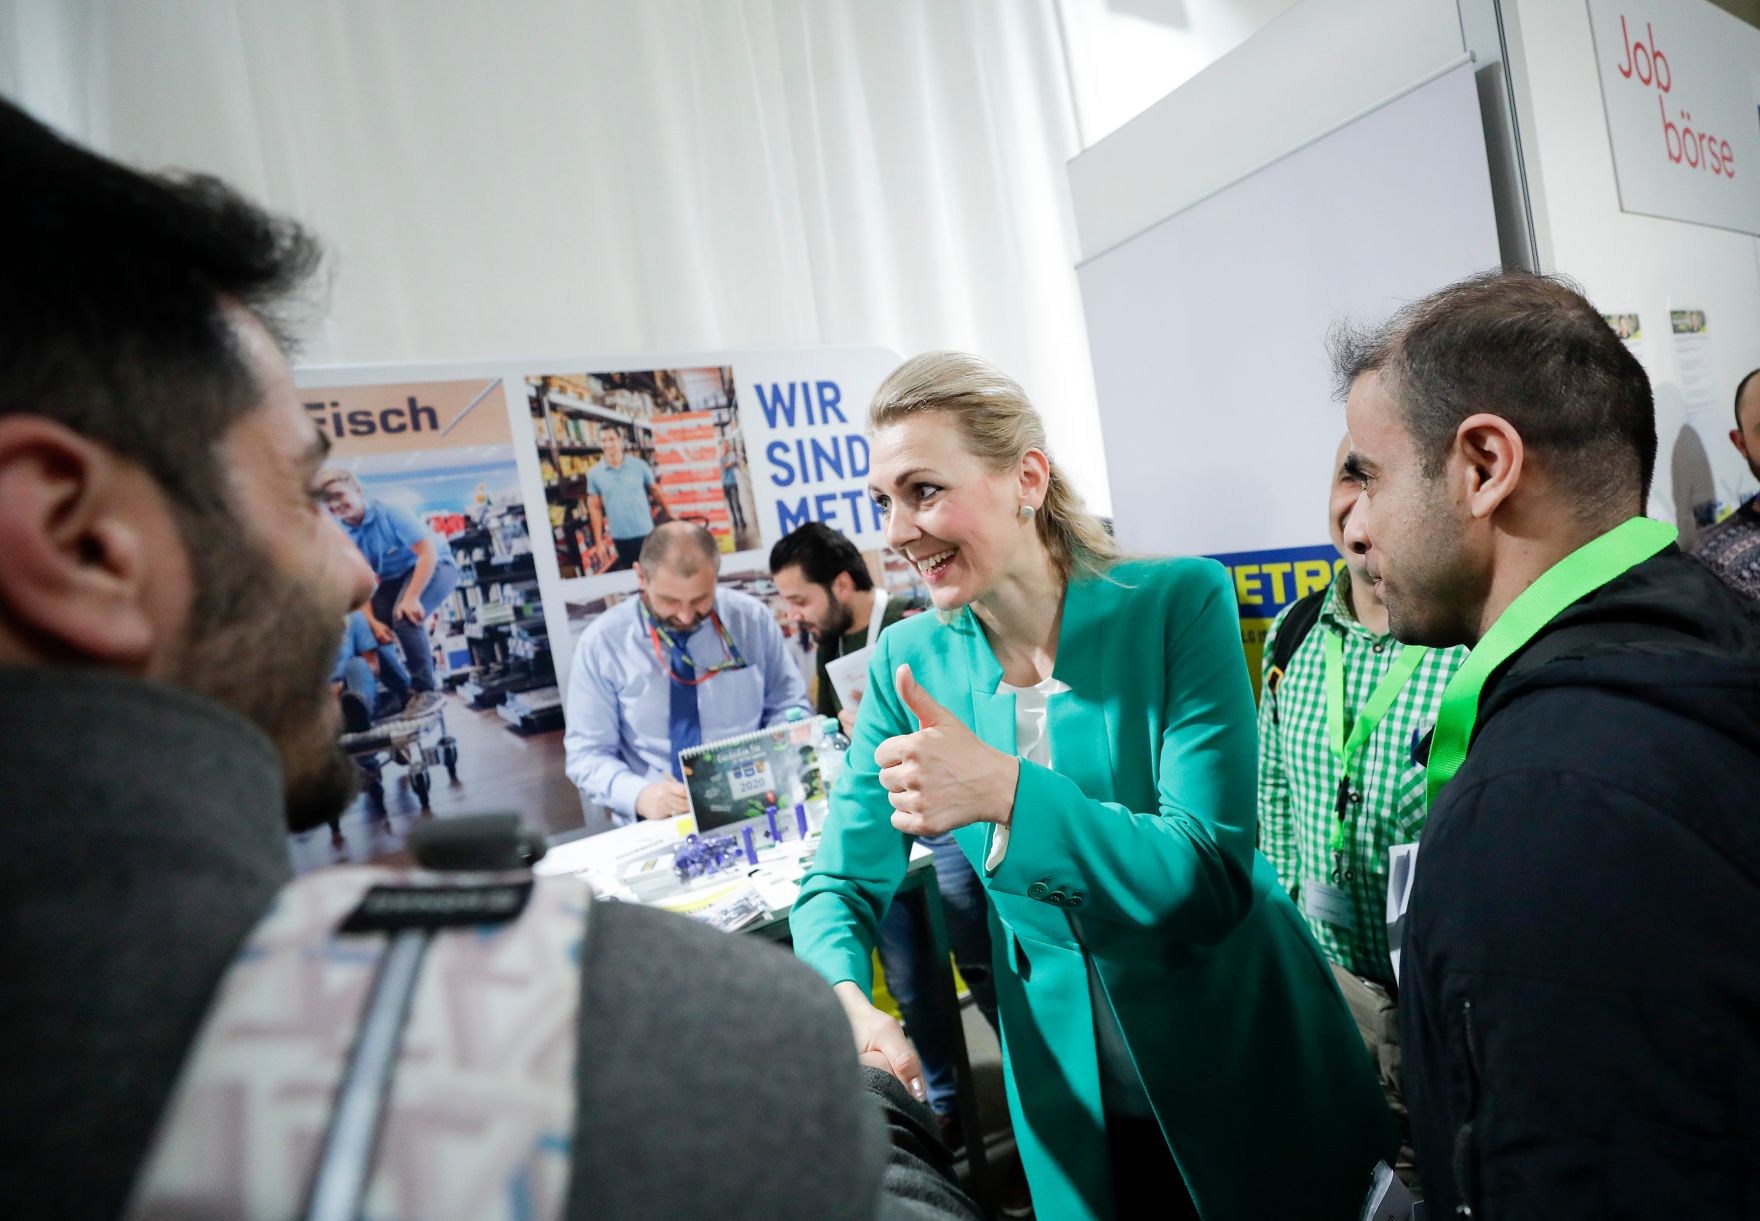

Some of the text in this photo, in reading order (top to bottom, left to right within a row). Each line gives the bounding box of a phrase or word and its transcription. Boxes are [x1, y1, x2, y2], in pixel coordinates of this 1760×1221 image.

[1617, 14, 1671, 93] Job
[1658, 94, 1734, 178] börse
[754, 380, 848, 429] WIR
[766, 434, 870, 487] SIND
[1226, 559, 1347, 605] ETR
[740, 777, 765, 793] 2020
